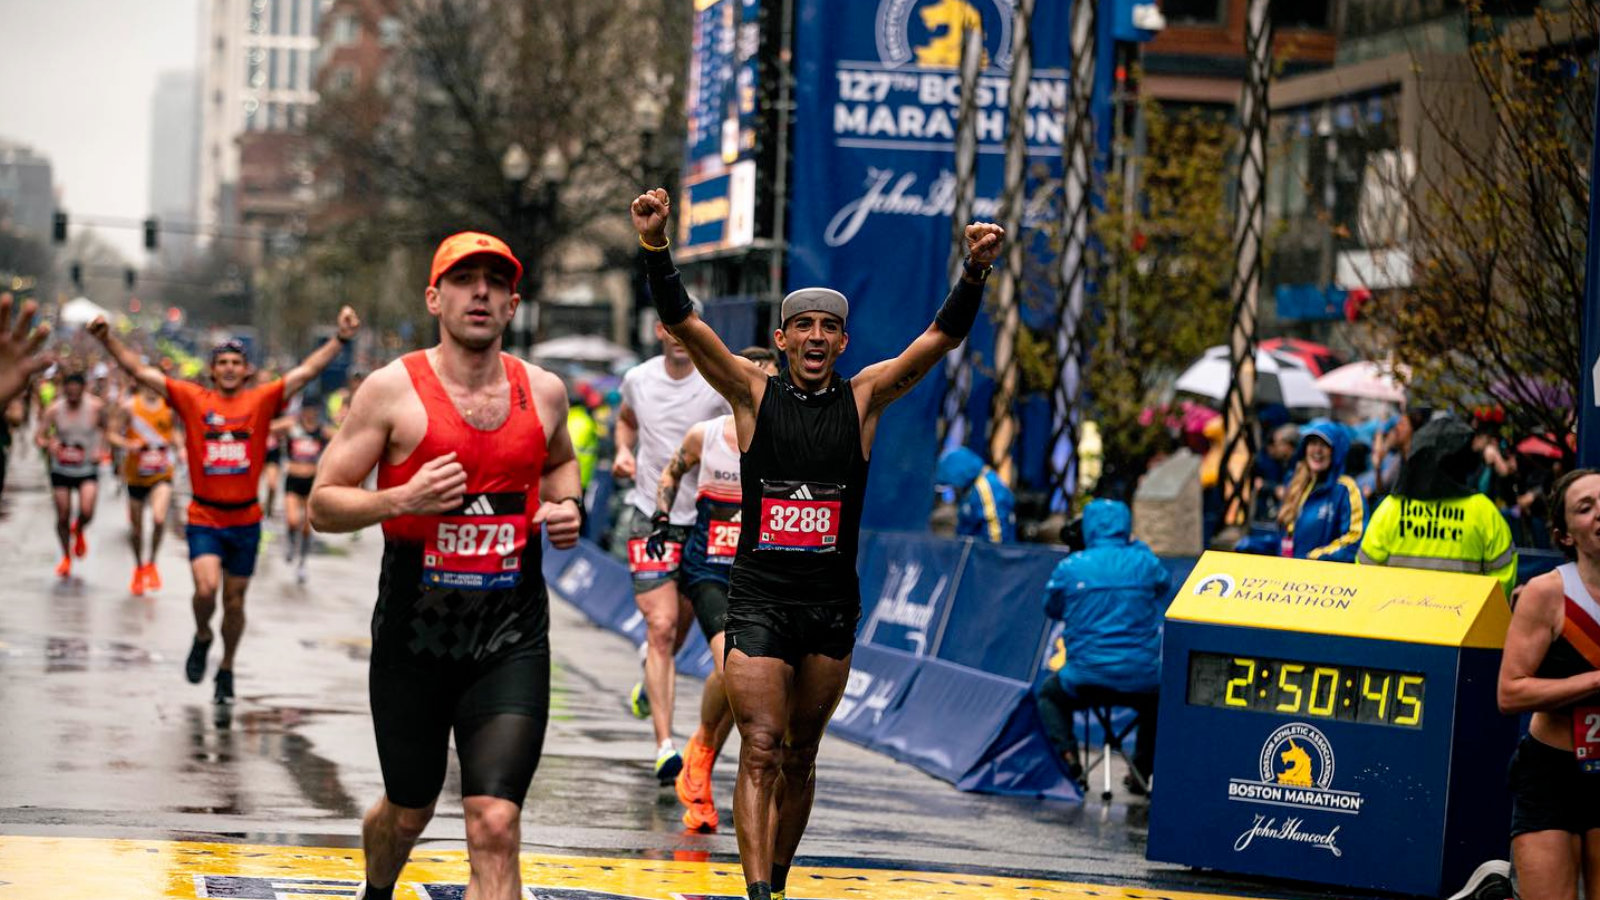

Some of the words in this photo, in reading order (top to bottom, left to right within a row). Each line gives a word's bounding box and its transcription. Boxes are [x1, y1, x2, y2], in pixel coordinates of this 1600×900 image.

[833, 102, 1066, 145] MARAHN
[715, 469, 739, 482] BOS
[770, 505, 831, 533] 3288
[1400, 497, 1464, 521] Boston
[437, 522, 516, 556] 5879
[1400, 520, 1463, 541] Police
[1234, 589, 1351, 610] MARATHON
[1282, 581, 1358, 598] BOSTON
[1225, 657, 1424, 726] 2:50:45
[1585, 713, 1600, 743] 2
[1262, 741, 1275, 780] BOSTON
[1274, 727, 1309, 744] ATHLETIC
[1309, 731, 1332, 786] ASSOCIATION
[1228, 782, 1282, 801] BOSTON
[1284, 789, 1361, 810] MARATHON
[1233, 813, 1280, 852] John
[1279, 815, 1342, 857] Hancock
